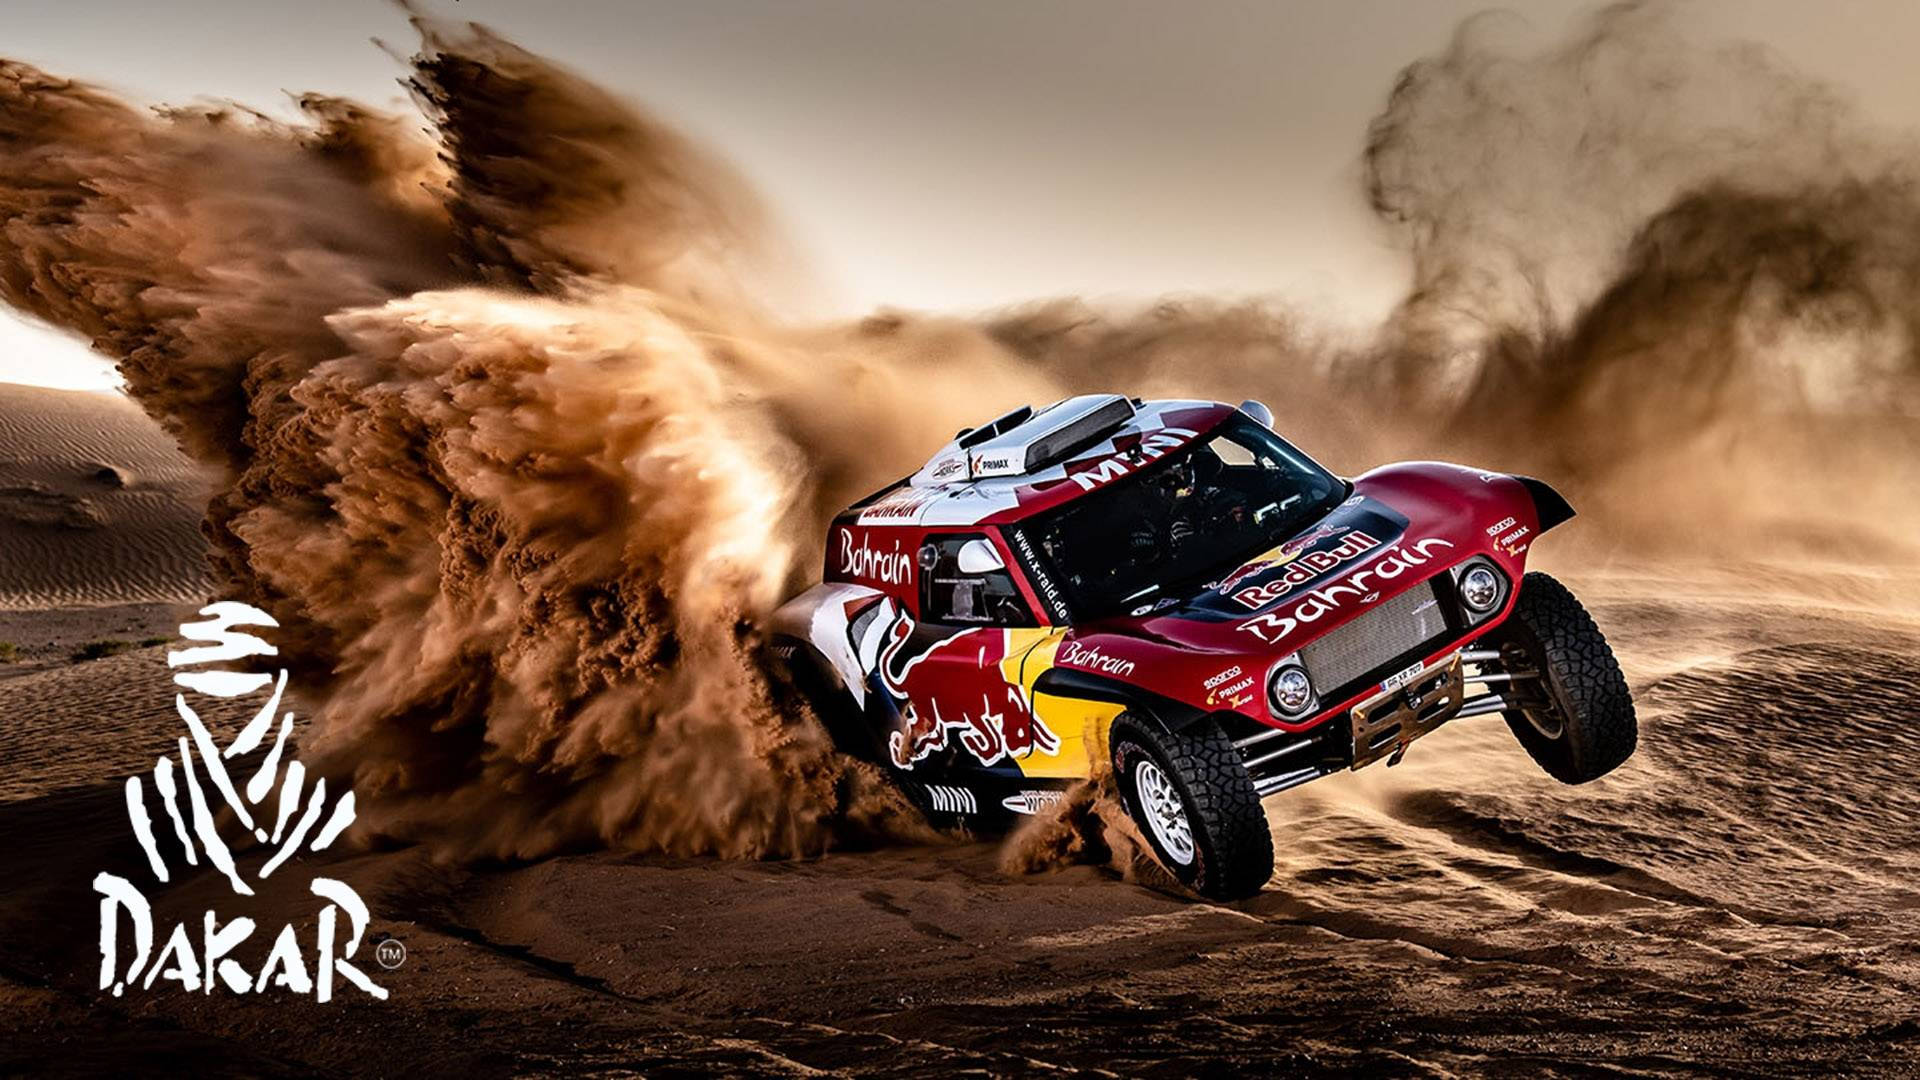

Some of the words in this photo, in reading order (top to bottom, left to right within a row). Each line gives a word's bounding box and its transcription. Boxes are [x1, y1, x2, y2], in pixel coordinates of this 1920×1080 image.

[983, 459, 1008, 470] PRIMAX
[841, 527, 911, 585] Bahrain
[1014, 529, 1067, 618] www.x-raid.de
[1236, 538, 1454, 644] Bahrain
[1060, 641, 1136, 677] Bahrain
[1219, 676, 1255, 699] PRIMAX
[924, 784, 977, 814] MINI
